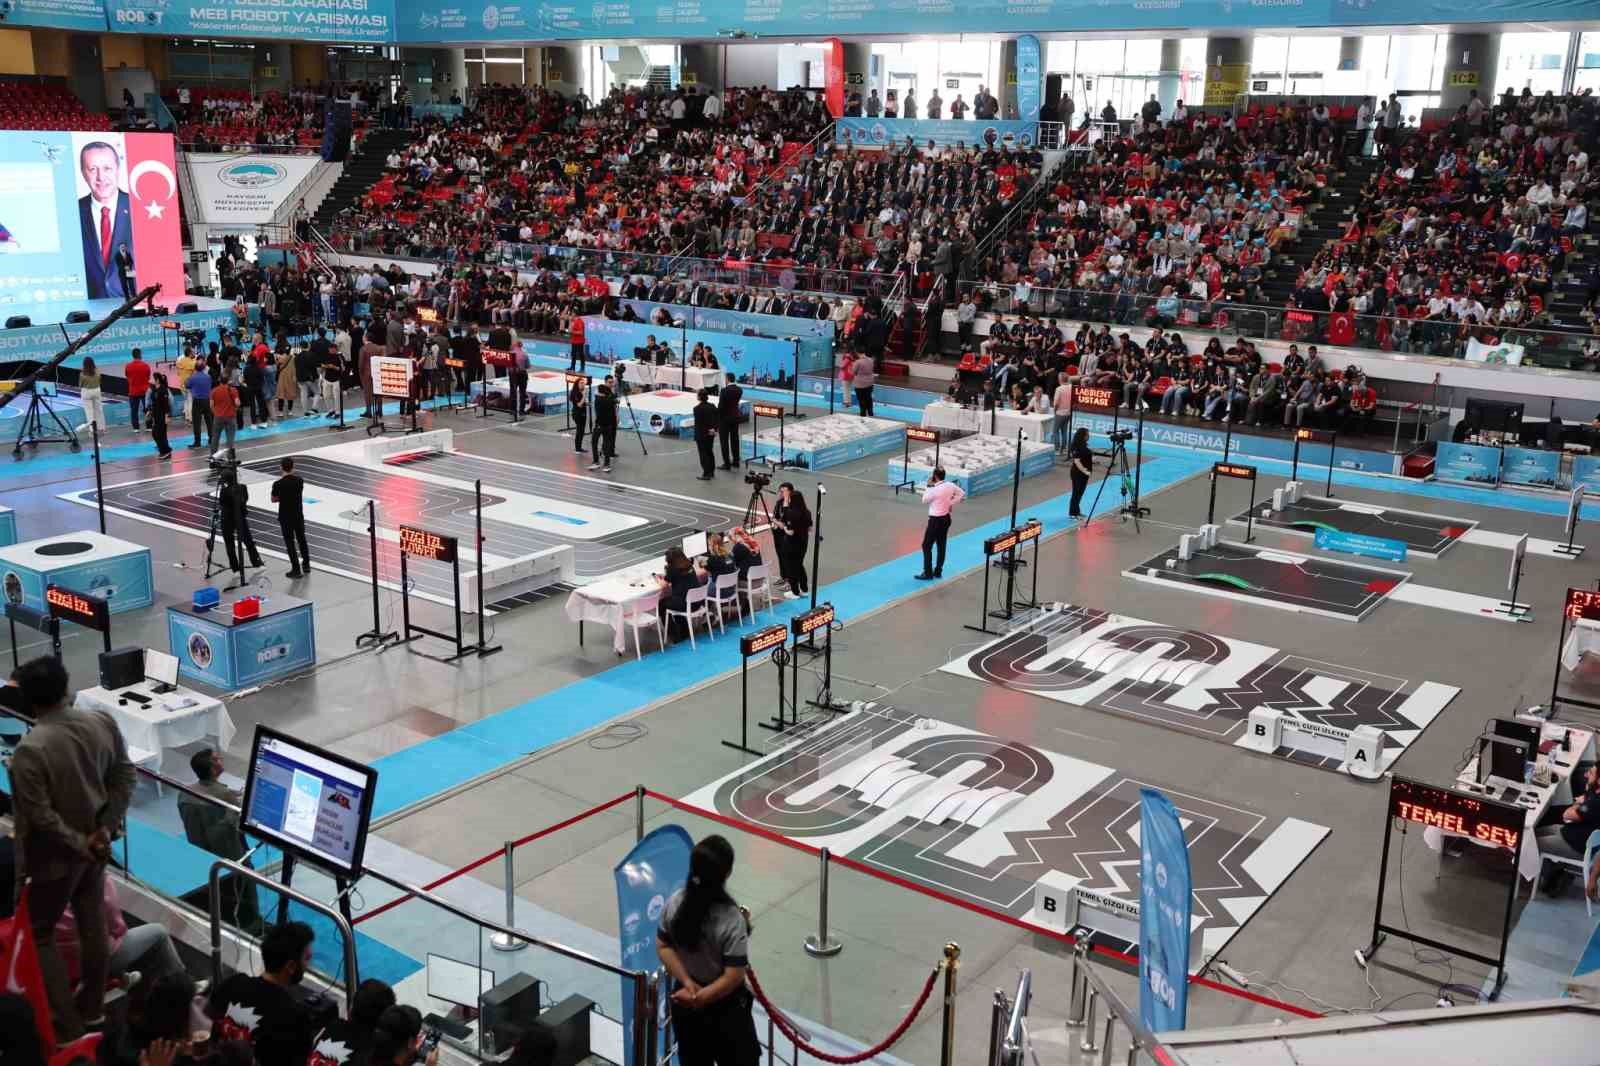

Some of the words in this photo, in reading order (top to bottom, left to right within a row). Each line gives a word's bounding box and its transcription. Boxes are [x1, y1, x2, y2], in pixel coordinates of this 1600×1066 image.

[190, 7, 228, 20] MEB
[231, 9, 290, 23] ROBOT
[1255, 724, 1266, 736] B
[1354, 749, 1367, 762] A
[1399, 801, 1469, 836] TEMEL
[1043, 896, 1057, 913] B
